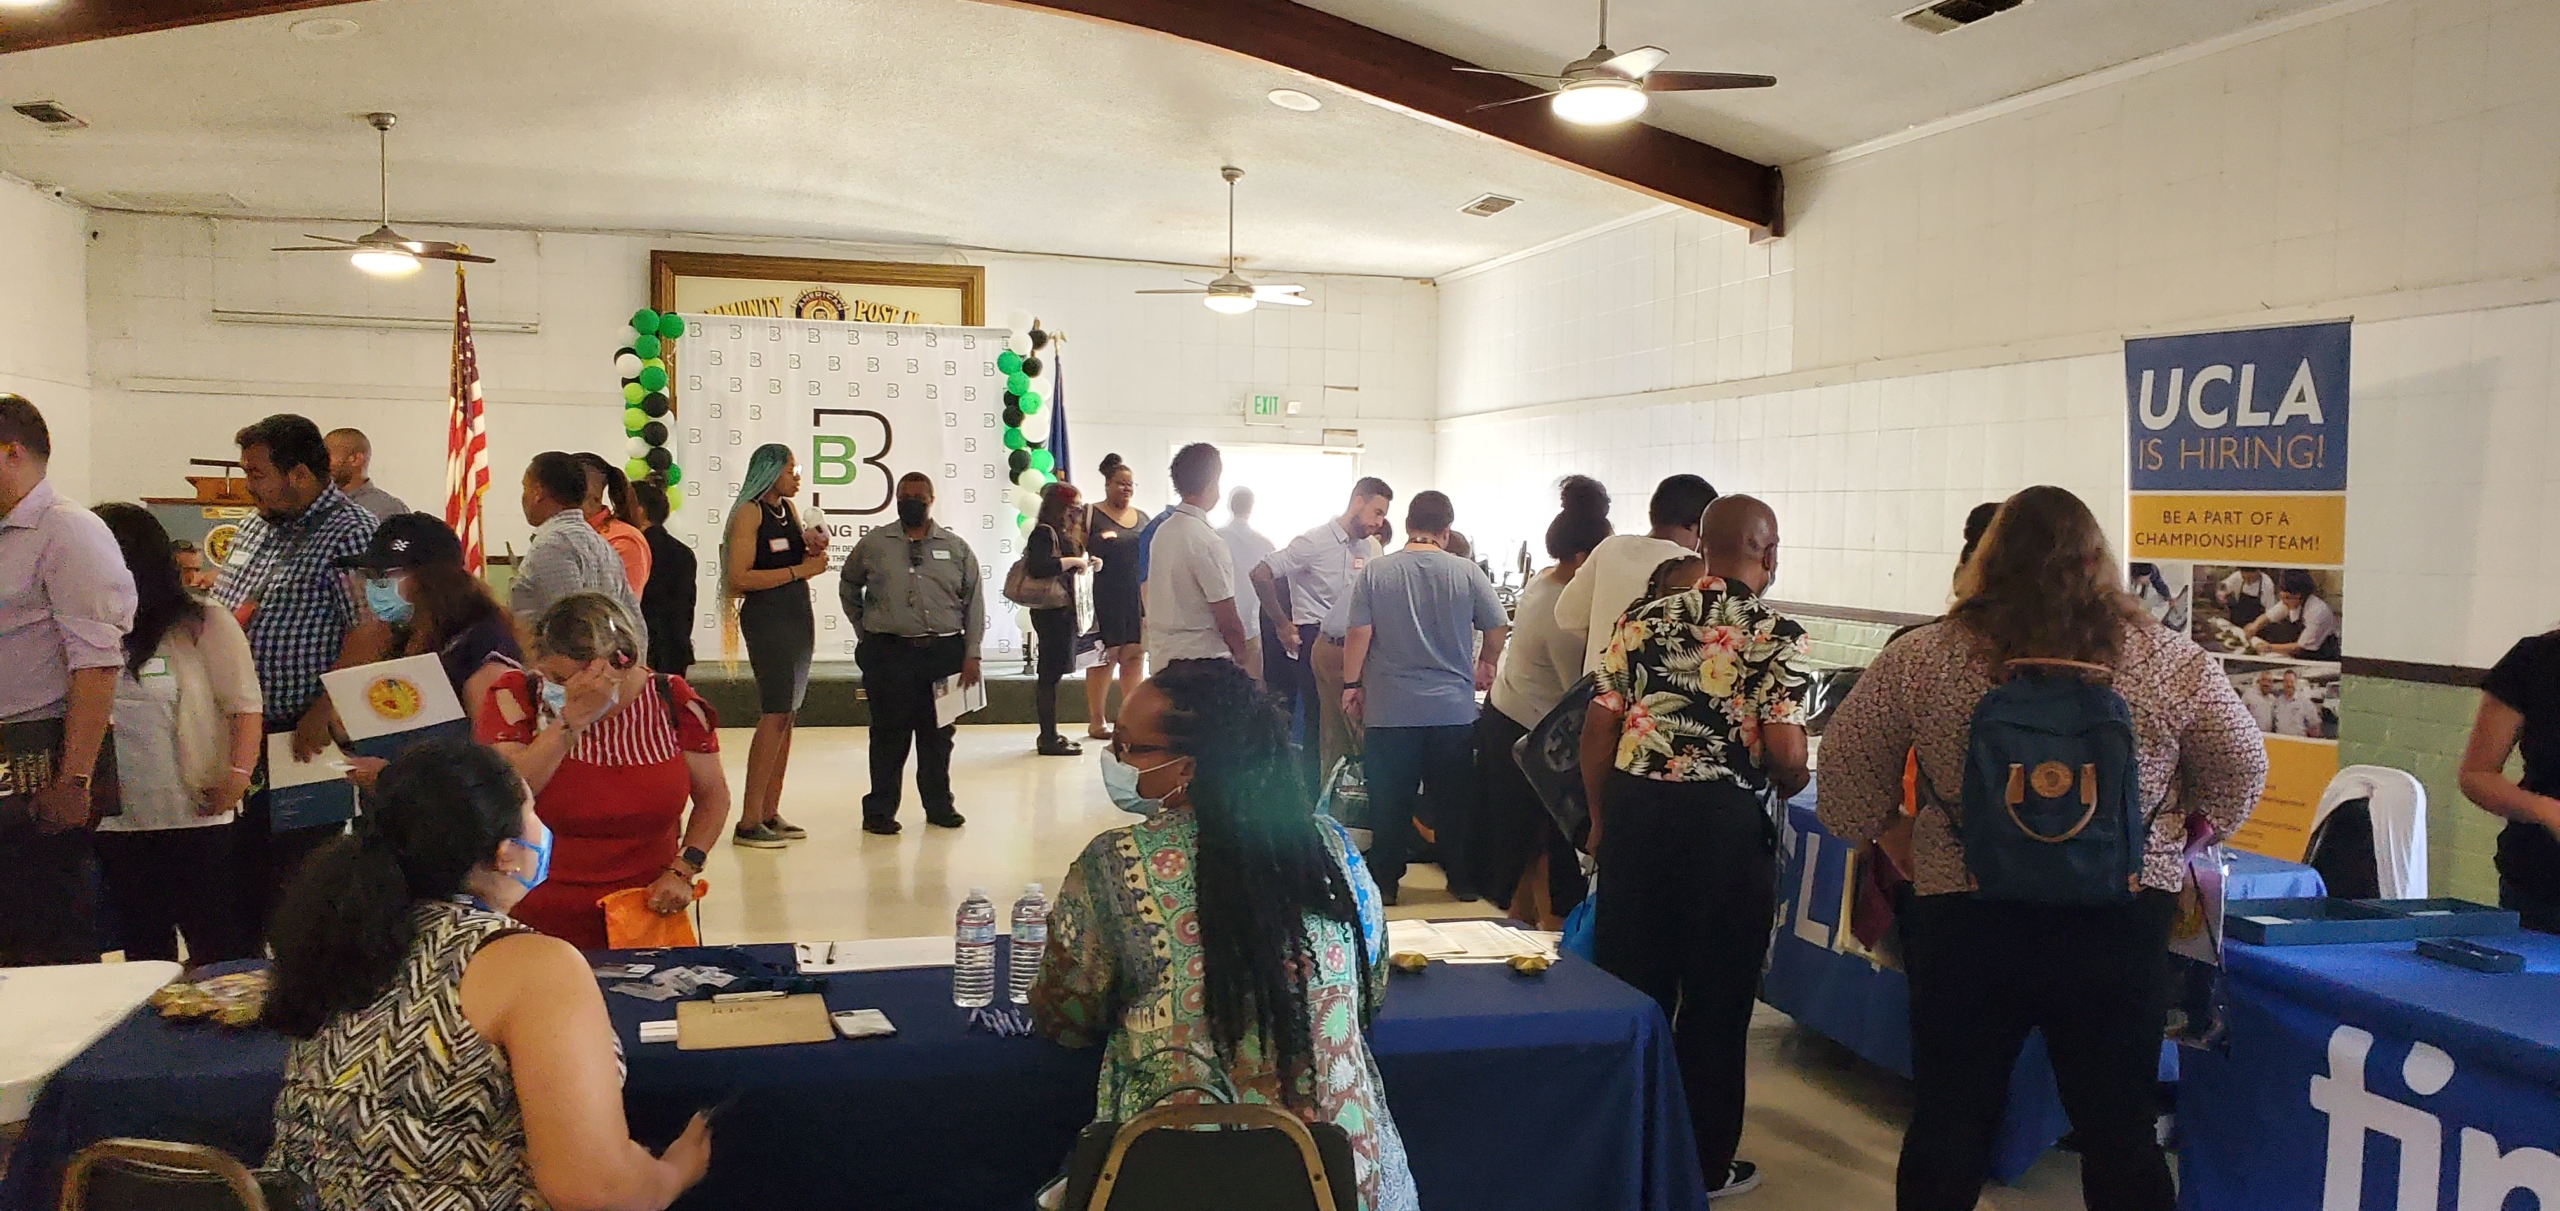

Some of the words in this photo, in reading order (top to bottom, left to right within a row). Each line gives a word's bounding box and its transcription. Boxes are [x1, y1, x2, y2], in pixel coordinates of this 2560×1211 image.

[798, 291, 844, 311] AMERICAN
[854, 299, 900, 323] POST
[2139, 357, 2324, 430] UCLA
[1254, 395, 1279, 415] EXIT
[2138, 438, 2164, 471] IS
[2180, 434, 2325, 470] HIRING!
[2162, 510, 2181, 524] BE
[2186, 511, 2198, 524] A
[2204, 510, 2243, 525] PART
[2251, 511, 2273, 525] OF
[2278, 512, 2290, 526] A
[2134, 532, 2263, 548] CHAMPIONSHIP
[2269, 535, 2321, 551] TEAM!
